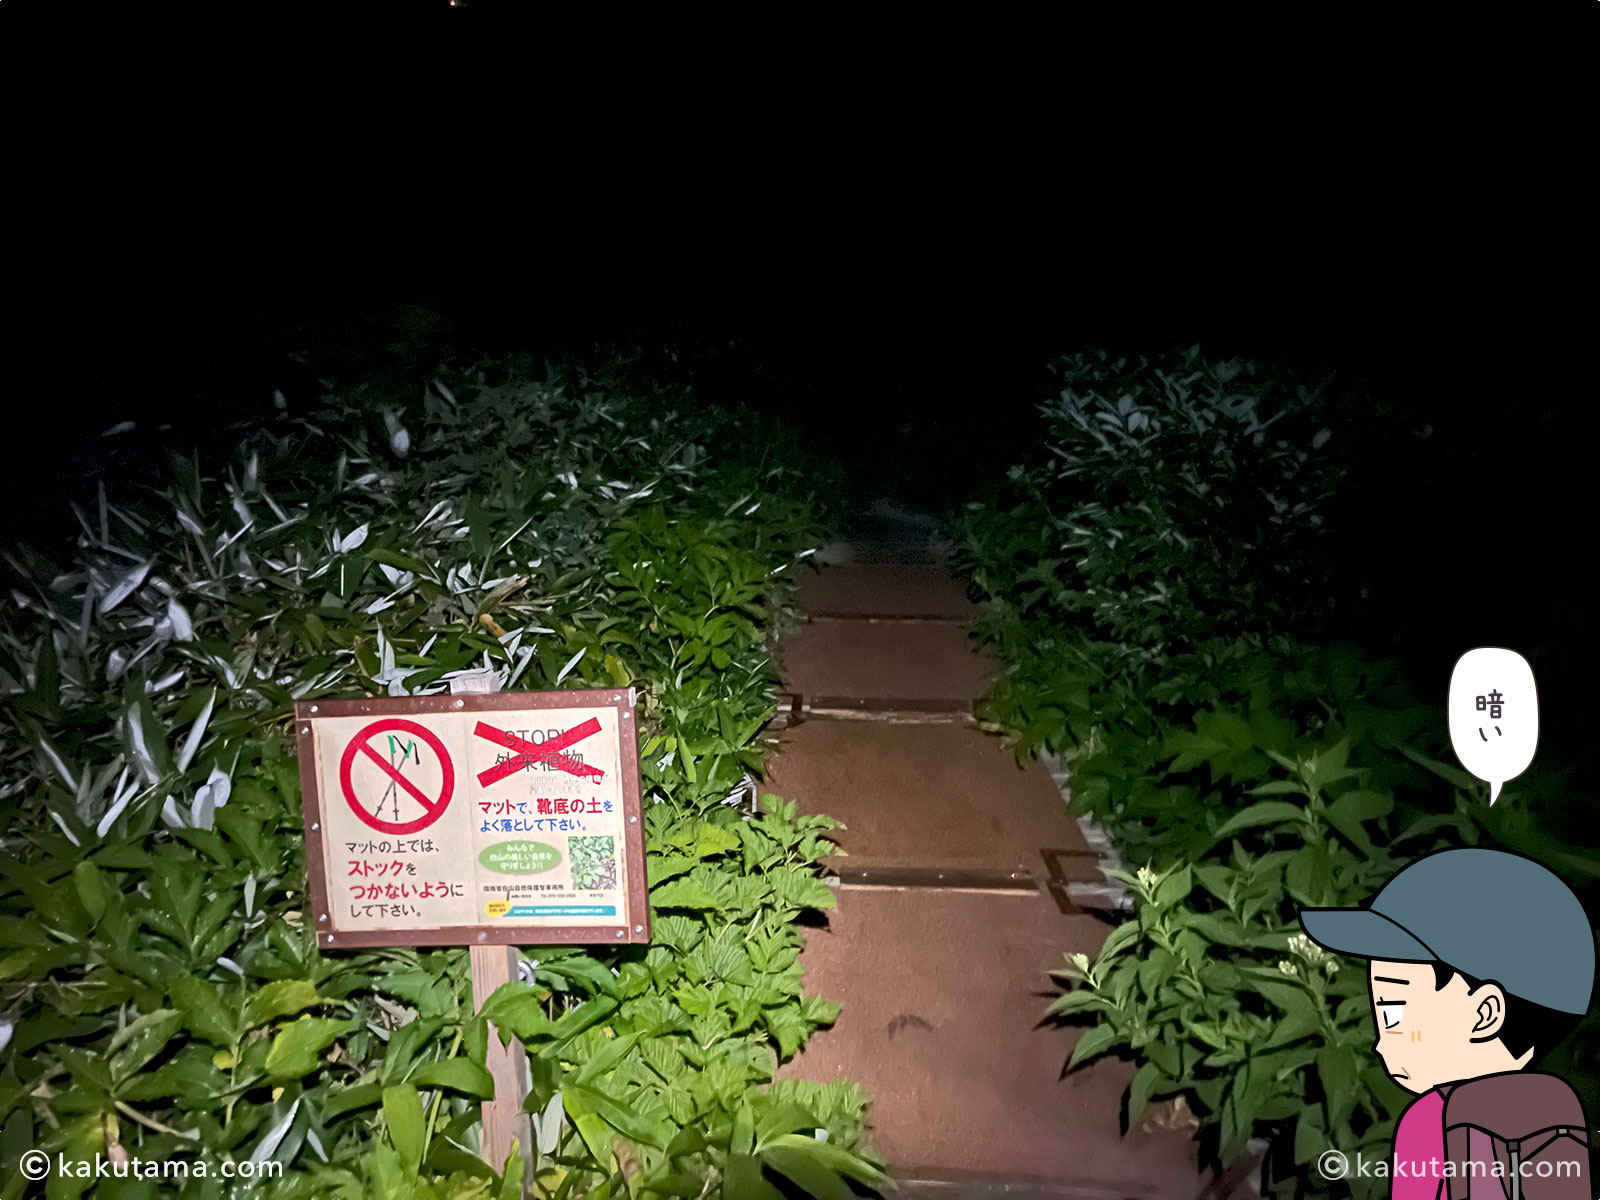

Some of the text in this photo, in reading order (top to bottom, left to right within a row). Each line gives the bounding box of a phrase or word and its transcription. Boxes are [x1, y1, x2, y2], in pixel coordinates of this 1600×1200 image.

[504, 728, 565, 747] STOP!
[495, 749, 584, 772] 外来植物
[478, 797, 613, 815] マットで、靴底の土を
[480, 818, 587, 832] よく落として下さい。
[345, 839, 440, 854] マットの上では、
[348, 859, 417, 877] ストックを
[349, 881, 464, 900] つかないように
[350, 903, 422, 918] して下さい。
